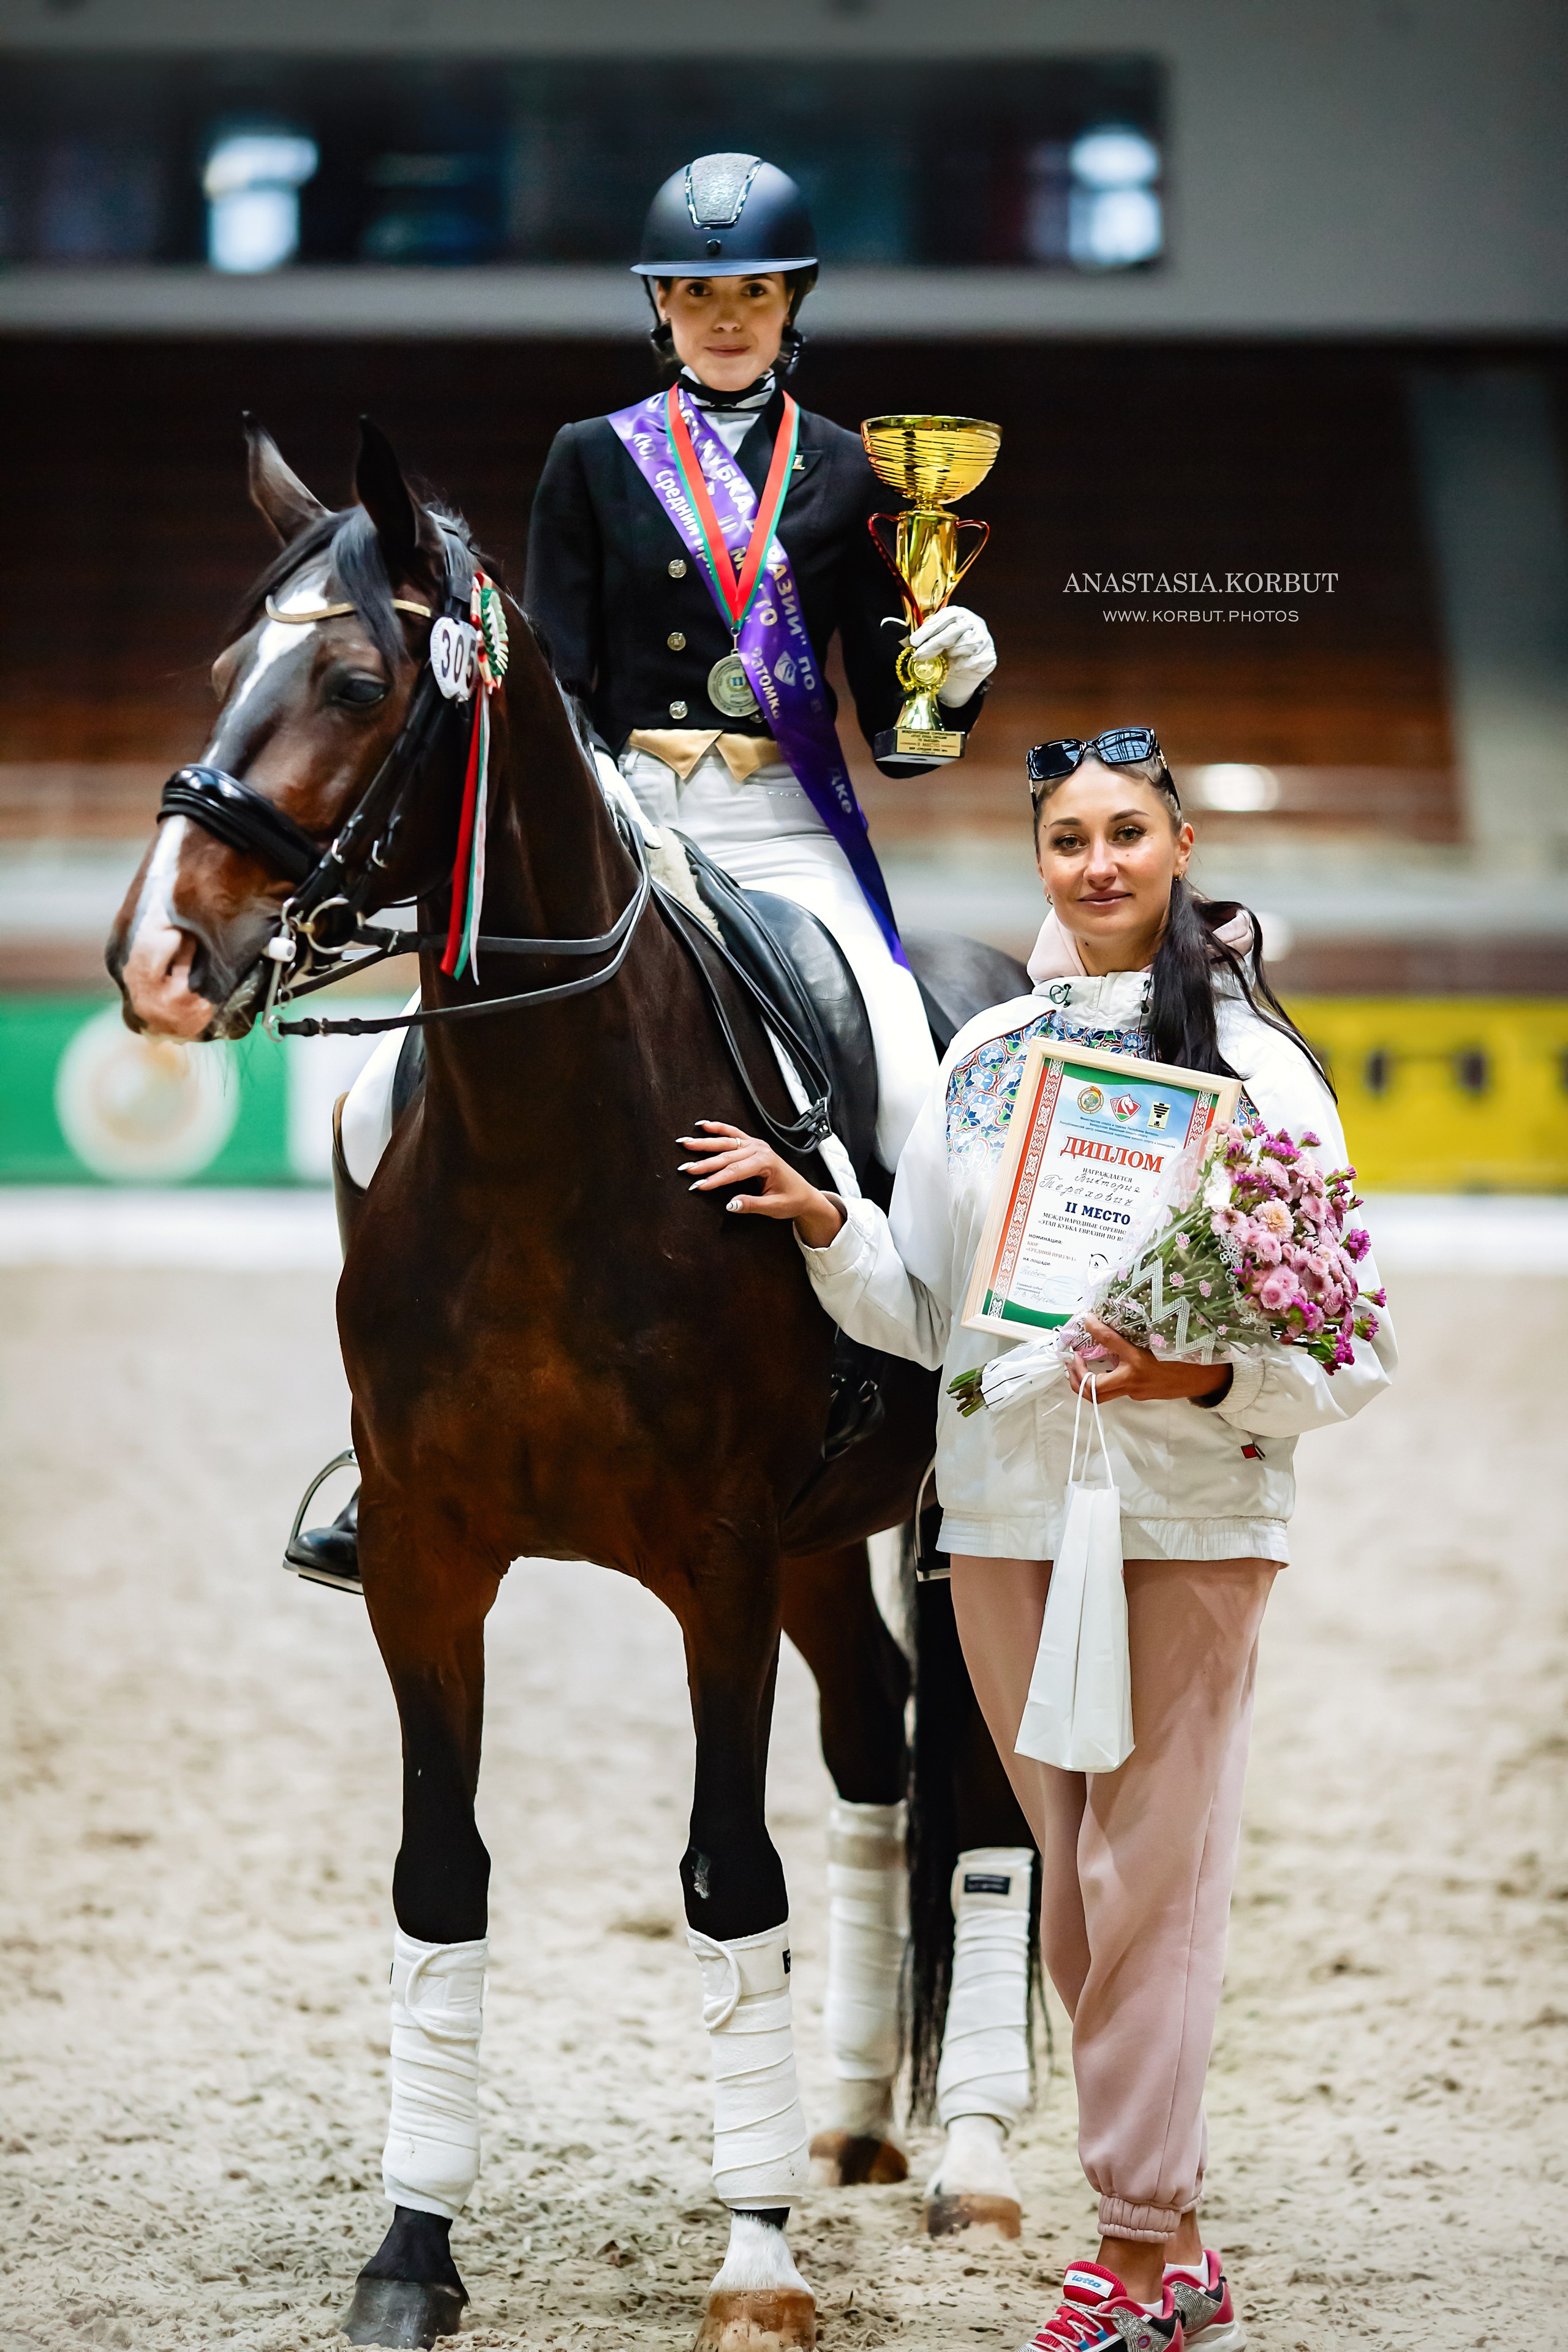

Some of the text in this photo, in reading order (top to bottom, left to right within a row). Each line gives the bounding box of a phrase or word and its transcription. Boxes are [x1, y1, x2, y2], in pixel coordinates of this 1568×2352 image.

[699, 439, 755, 514] КУБКА
[798, 656, 815, 690] ПО
[1060, 1136, 1164, 1173] ДИПЛОМ
[1083, 1167, 1133, 1183] НАГРАЖДАЕТСЯ
[1042, 1212, 1126, 1235] МЕЖДУНАРОДНЫЕ СОРЕВНО
[1065, 1201, 1131, 1225] II МЕСТО
[1028, 1233, 1063, 1245] НОМИНАЦИЯ:
[1058, 1222, 1077, 1232] КУБКА
[1079, 1227, 1106, 1238] ЕВРАЗИИ
